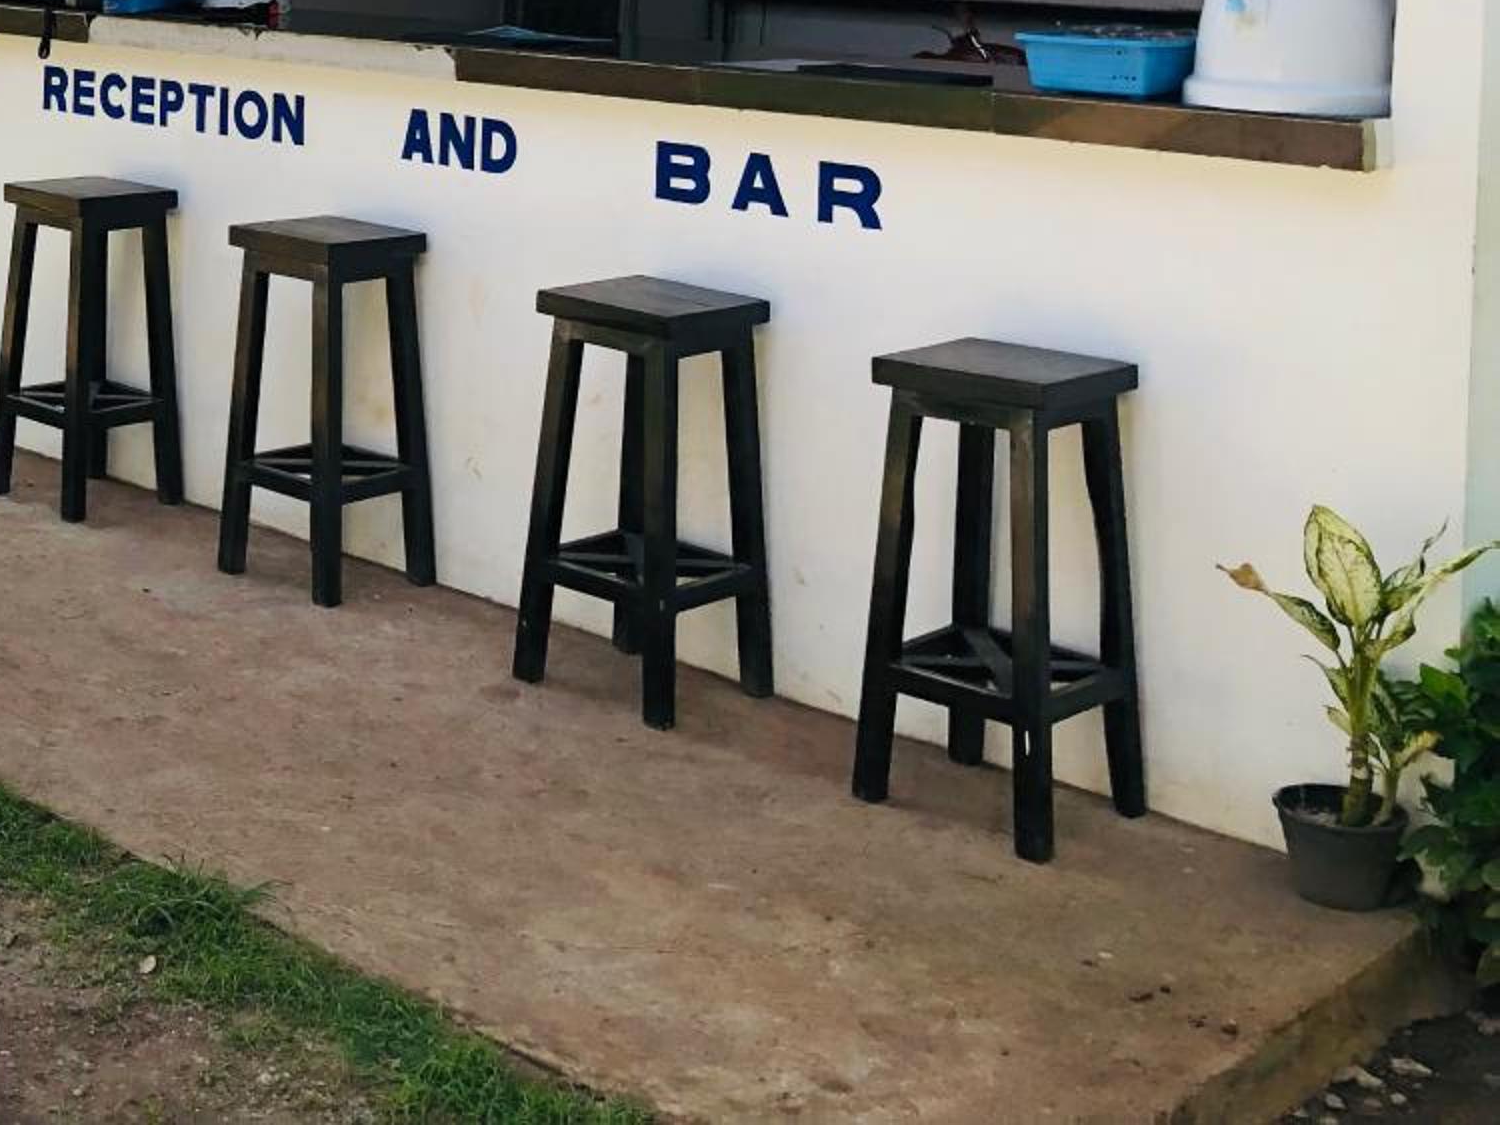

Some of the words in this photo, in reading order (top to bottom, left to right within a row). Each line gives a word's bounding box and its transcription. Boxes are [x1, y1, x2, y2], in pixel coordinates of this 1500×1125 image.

[43, 65, 305, 146] RECEPTION
[401, 109, 518, 174] AND
[655, 140, 883, 230] BAR
